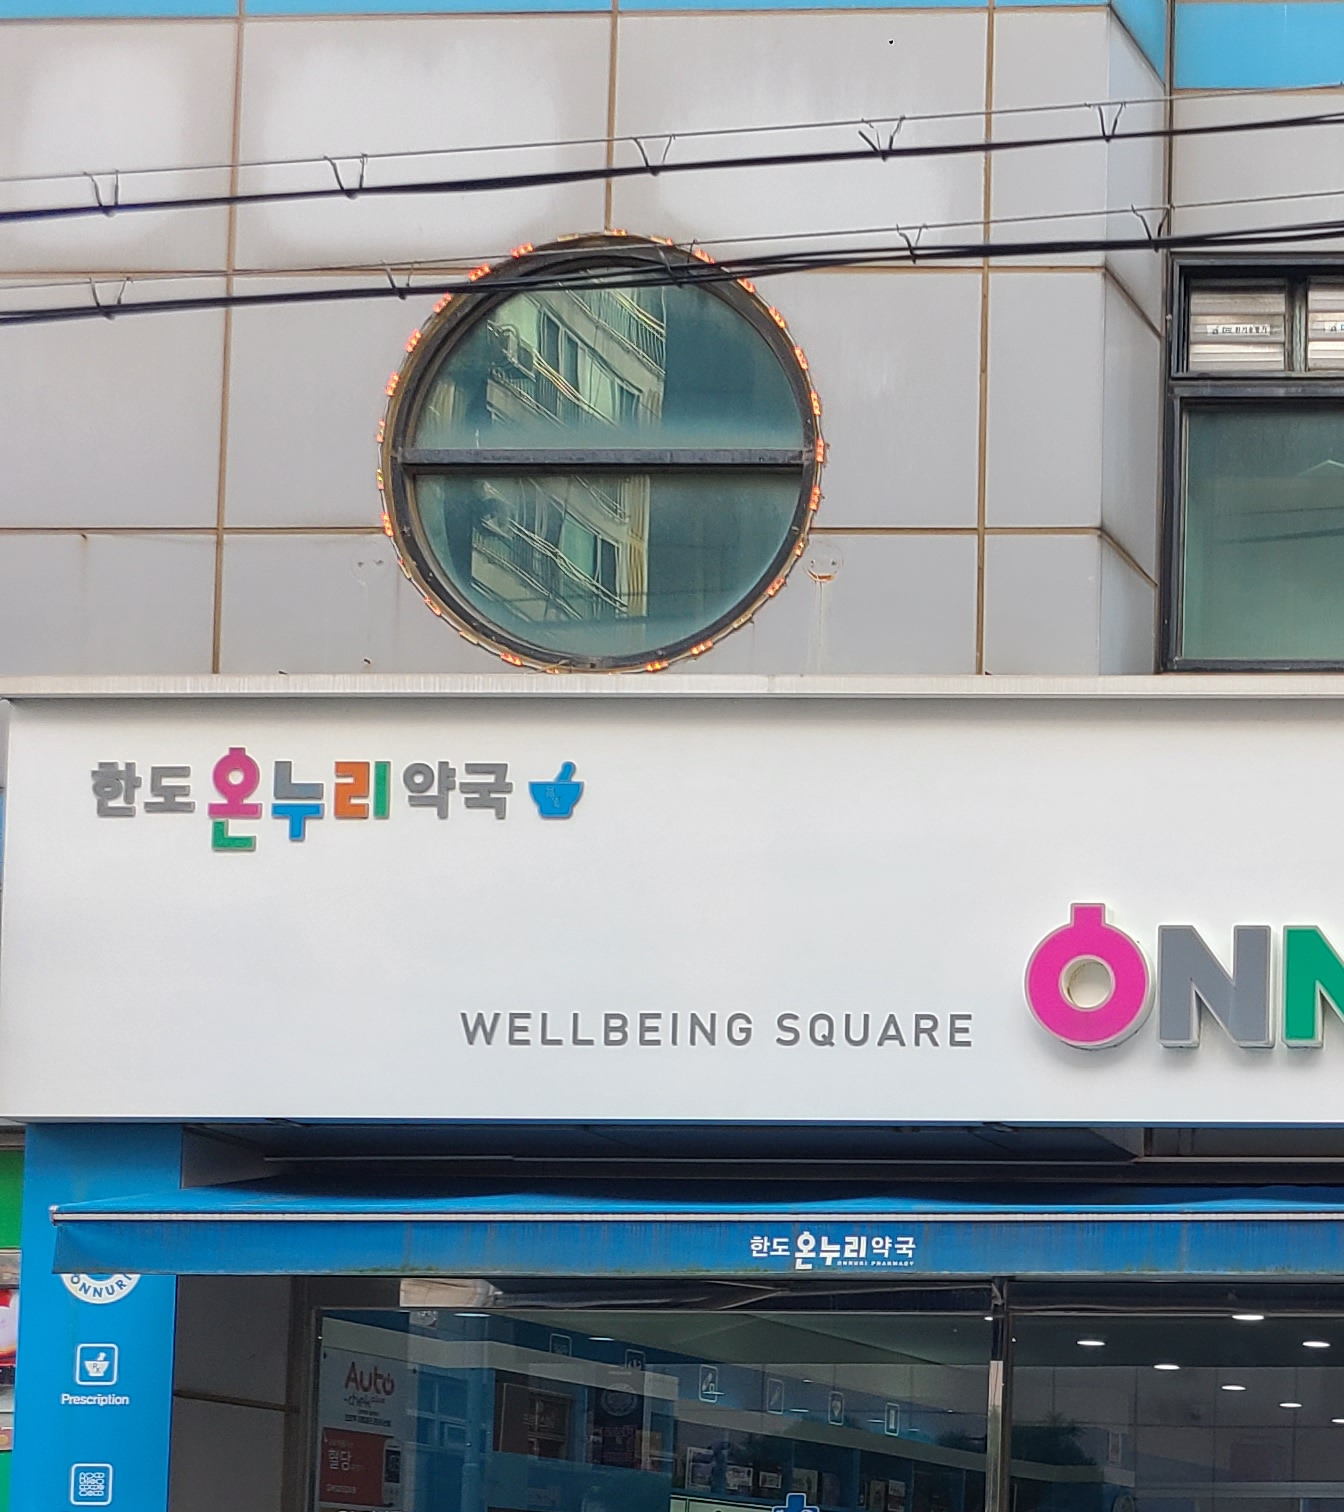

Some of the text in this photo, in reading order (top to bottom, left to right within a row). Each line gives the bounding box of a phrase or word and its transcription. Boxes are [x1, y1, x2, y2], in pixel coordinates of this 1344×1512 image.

[460, 1013, 974, 1050] WELLBEING SQUARE
[69, 1273, 132, 1299] ONNURI
[61, 1393, 129, 1407] Prescription
